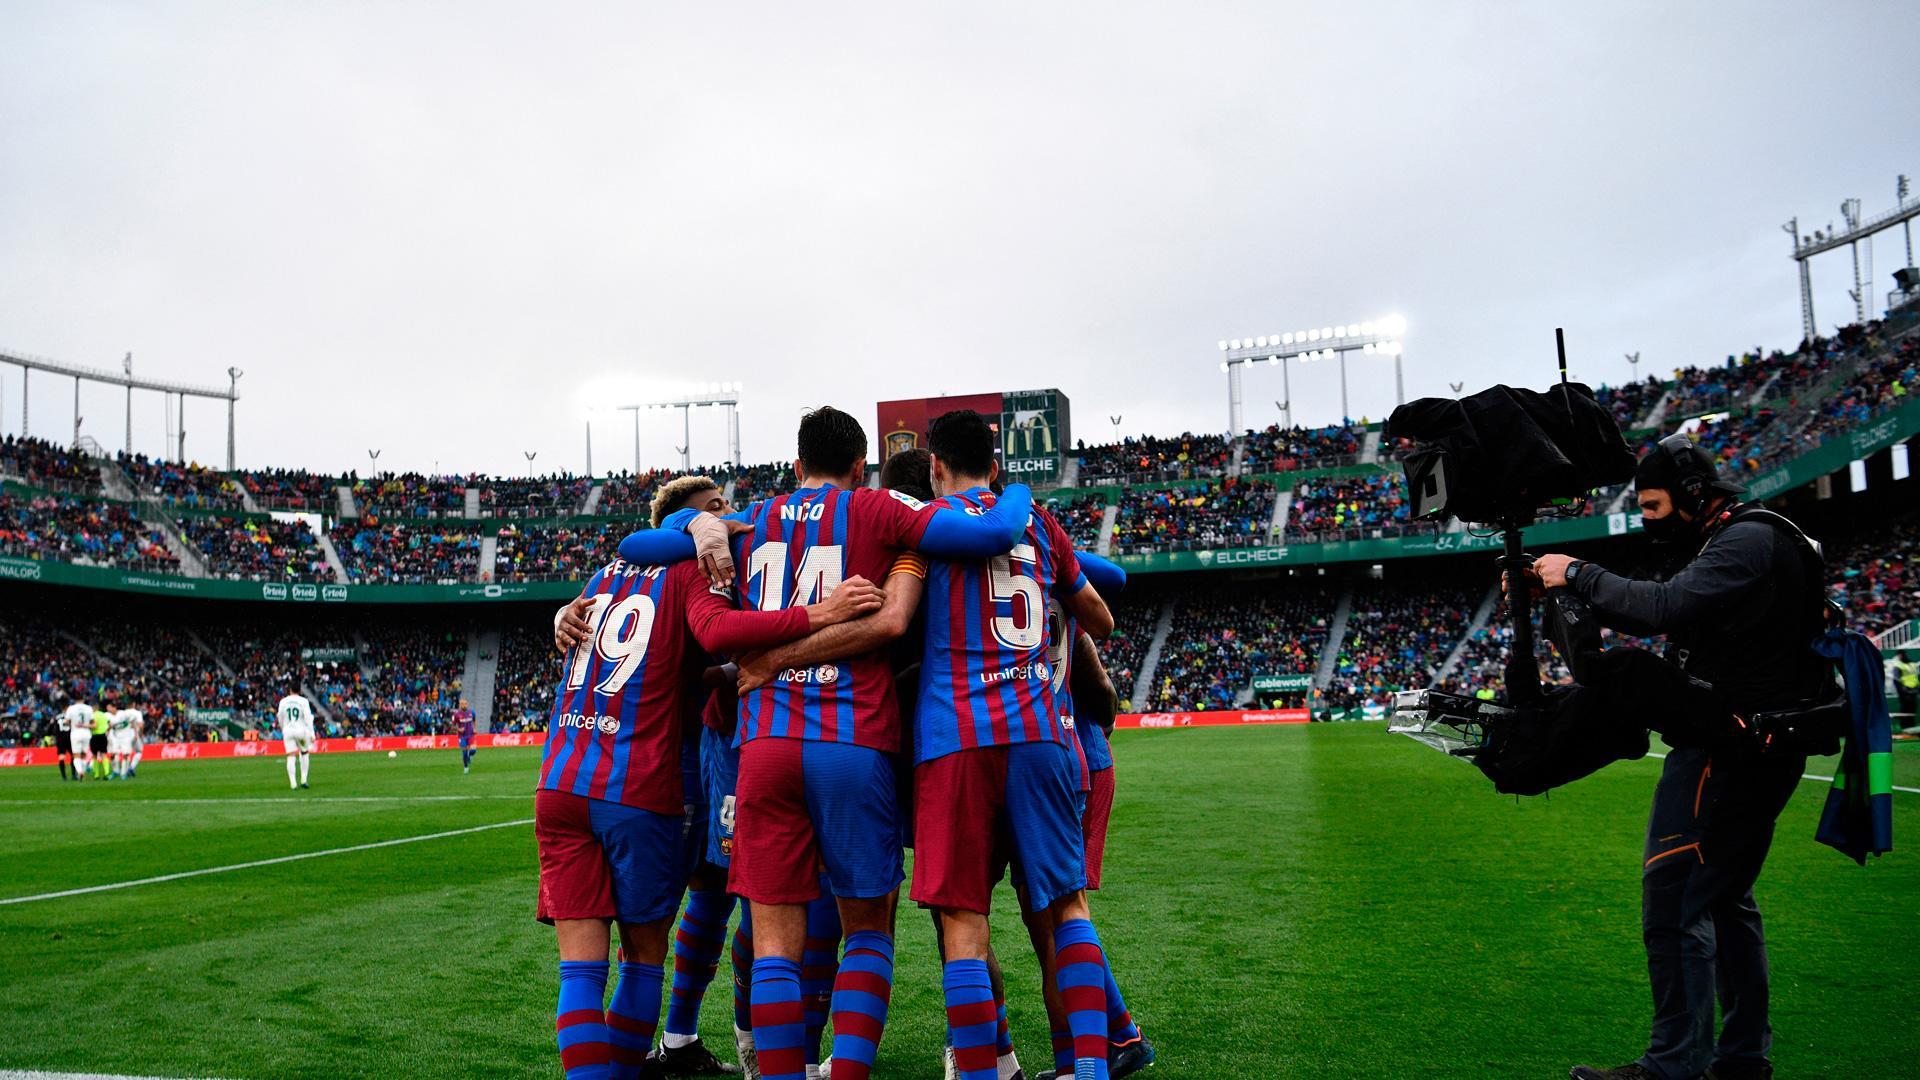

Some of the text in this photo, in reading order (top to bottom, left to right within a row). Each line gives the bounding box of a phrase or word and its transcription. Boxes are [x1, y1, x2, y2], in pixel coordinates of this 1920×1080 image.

[1008, 459, 1053, 473] ELCHE
[780, 502, 825, 523] NICO
[747, 541, 843, 612] 14
[987, 543, 1044, 650] 5
[567, 593, 656, 697] 19
[981, 661, 1033, 683] unicef
[1254, 677, 1312, 689] cableworld
[286, 707, 300, 721] 19
